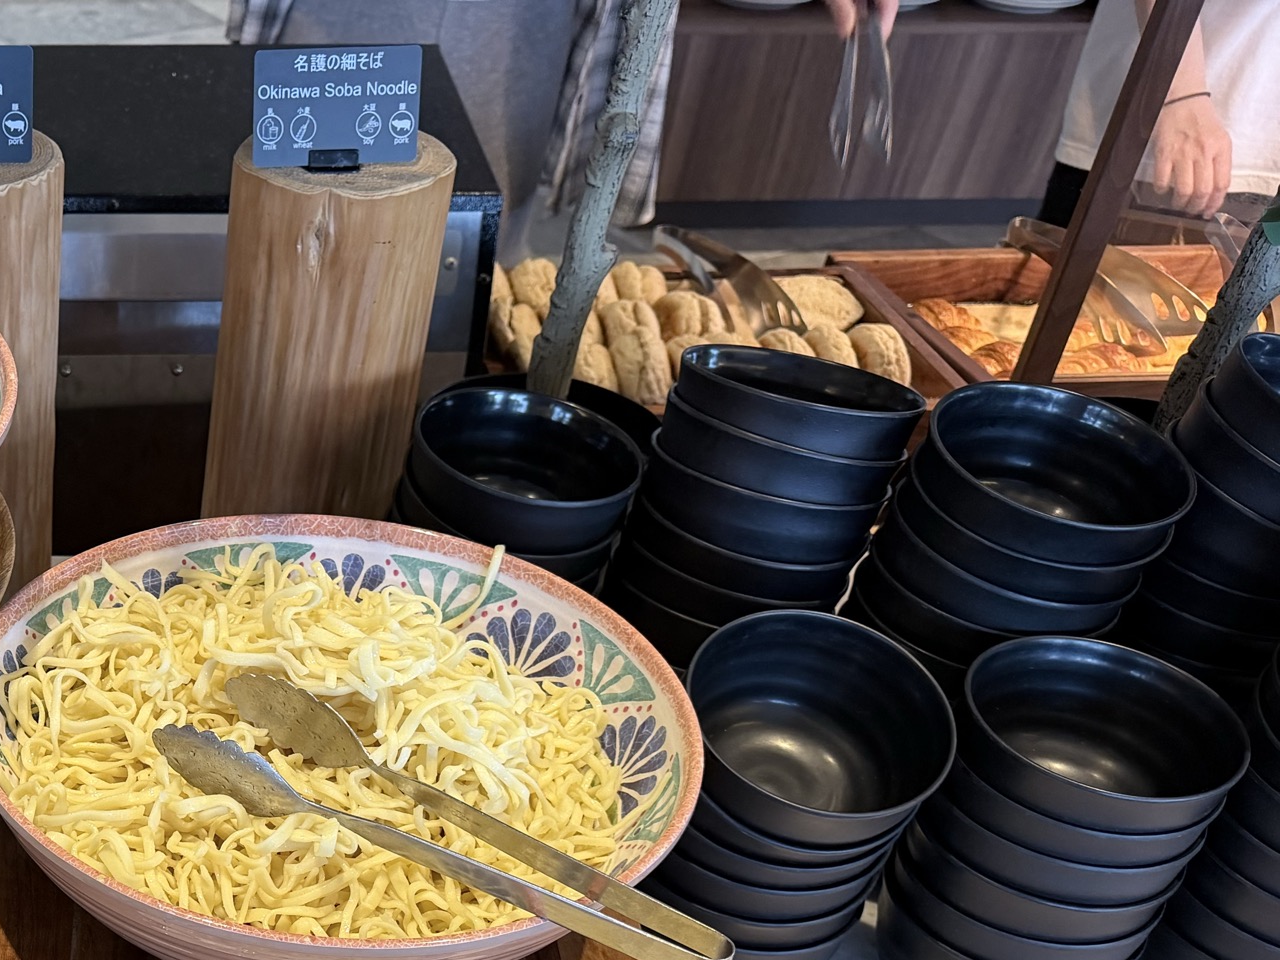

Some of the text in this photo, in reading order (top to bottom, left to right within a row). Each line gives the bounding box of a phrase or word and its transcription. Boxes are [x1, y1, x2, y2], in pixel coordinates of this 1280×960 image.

[294, 51, 385, 73] 名護の細そば
[257, 80, 417, 100] Okinawa Soba Noodle
[8, 138, 24, 146] pork
[262, 137, 410, 151] milk wheat soy pork
